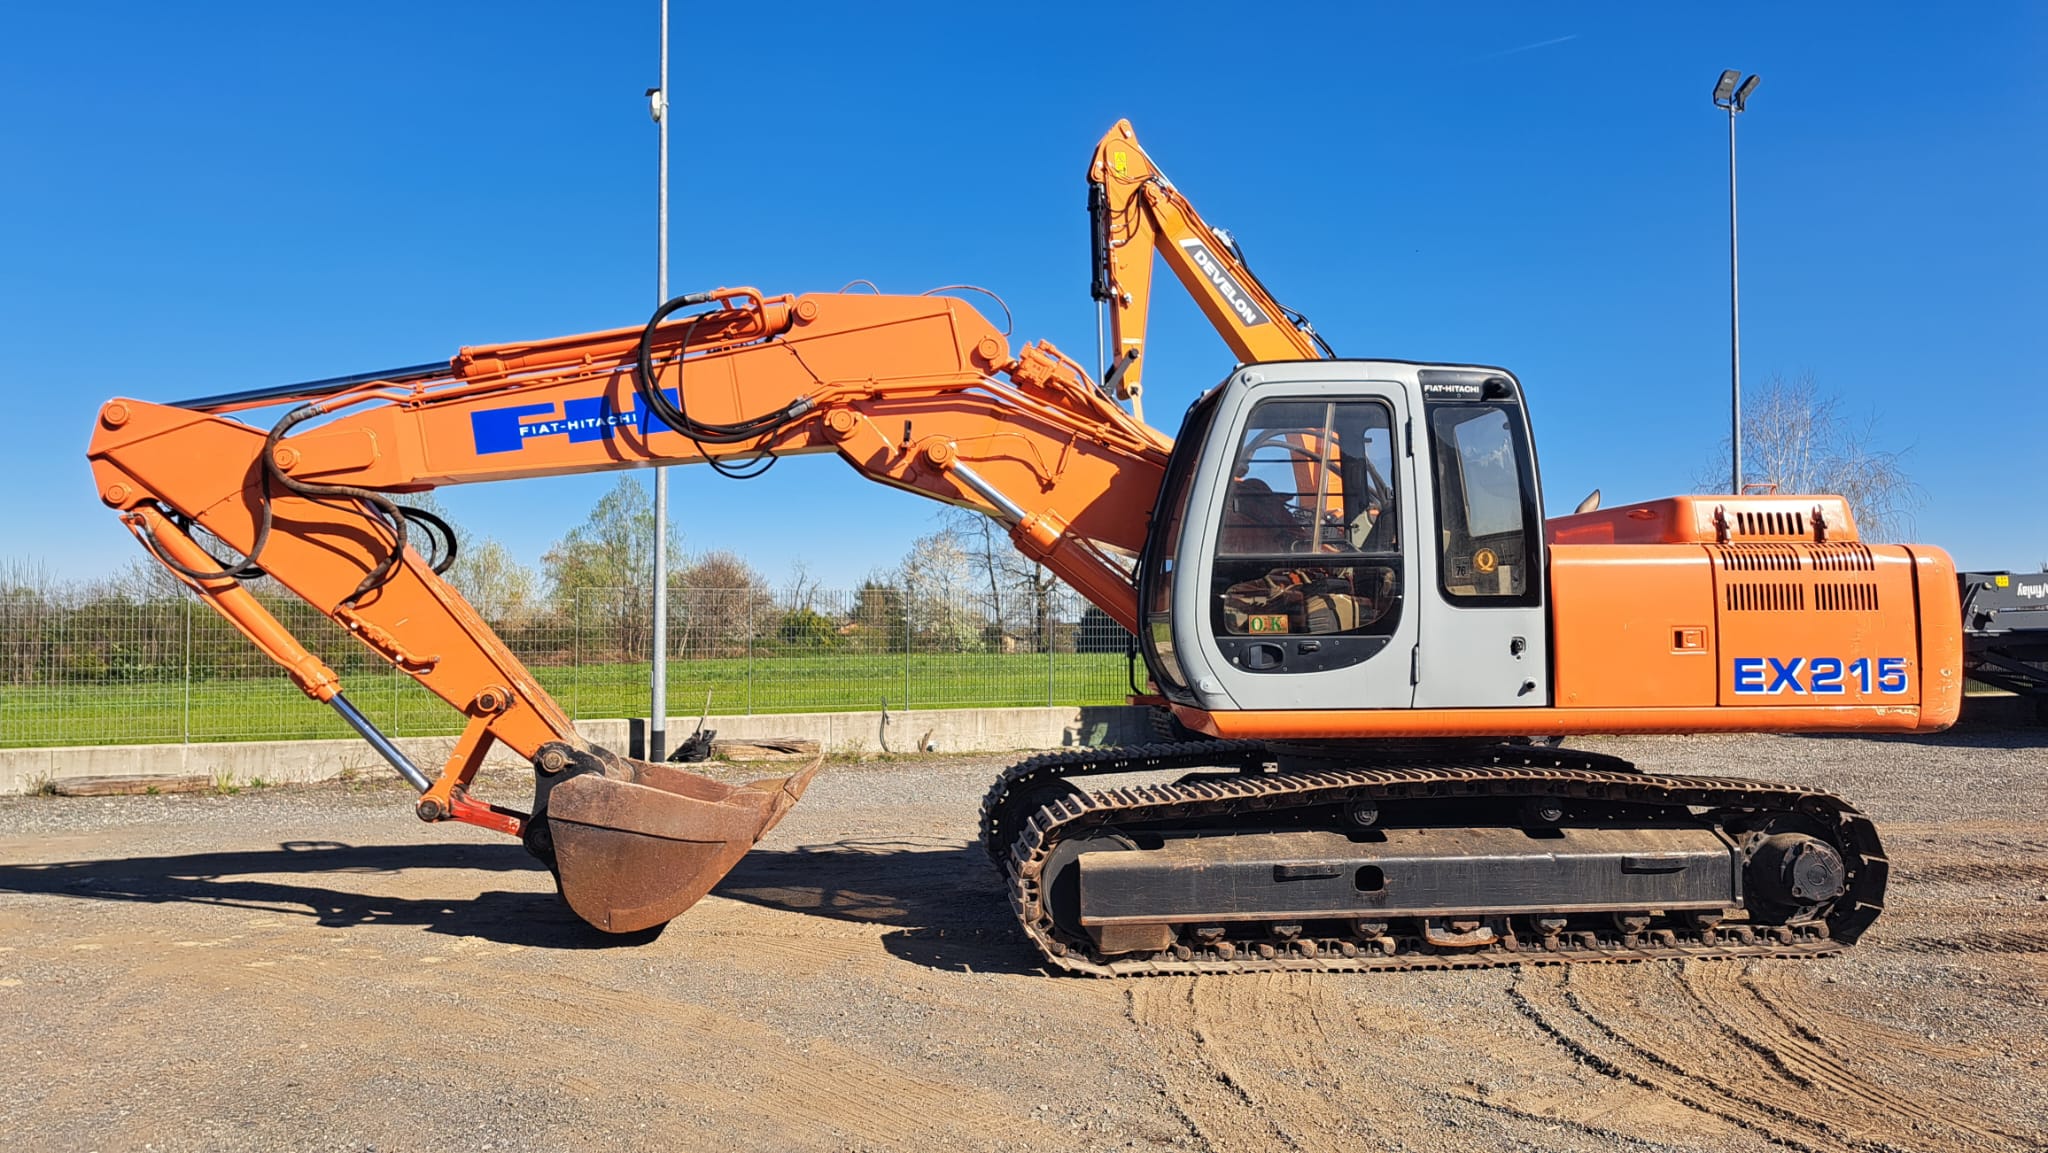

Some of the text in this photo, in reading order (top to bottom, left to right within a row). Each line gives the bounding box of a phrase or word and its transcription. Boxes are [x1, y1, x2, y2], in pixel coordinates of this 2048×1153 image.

[1193, 249, 1257, 324] DEVELON
[1424, 384, 1480, 393] FIAT-HITACHI
[519, 413, 638, 437] FIAT-HITACHI
[1734, 657, 1909, 695] EX215
